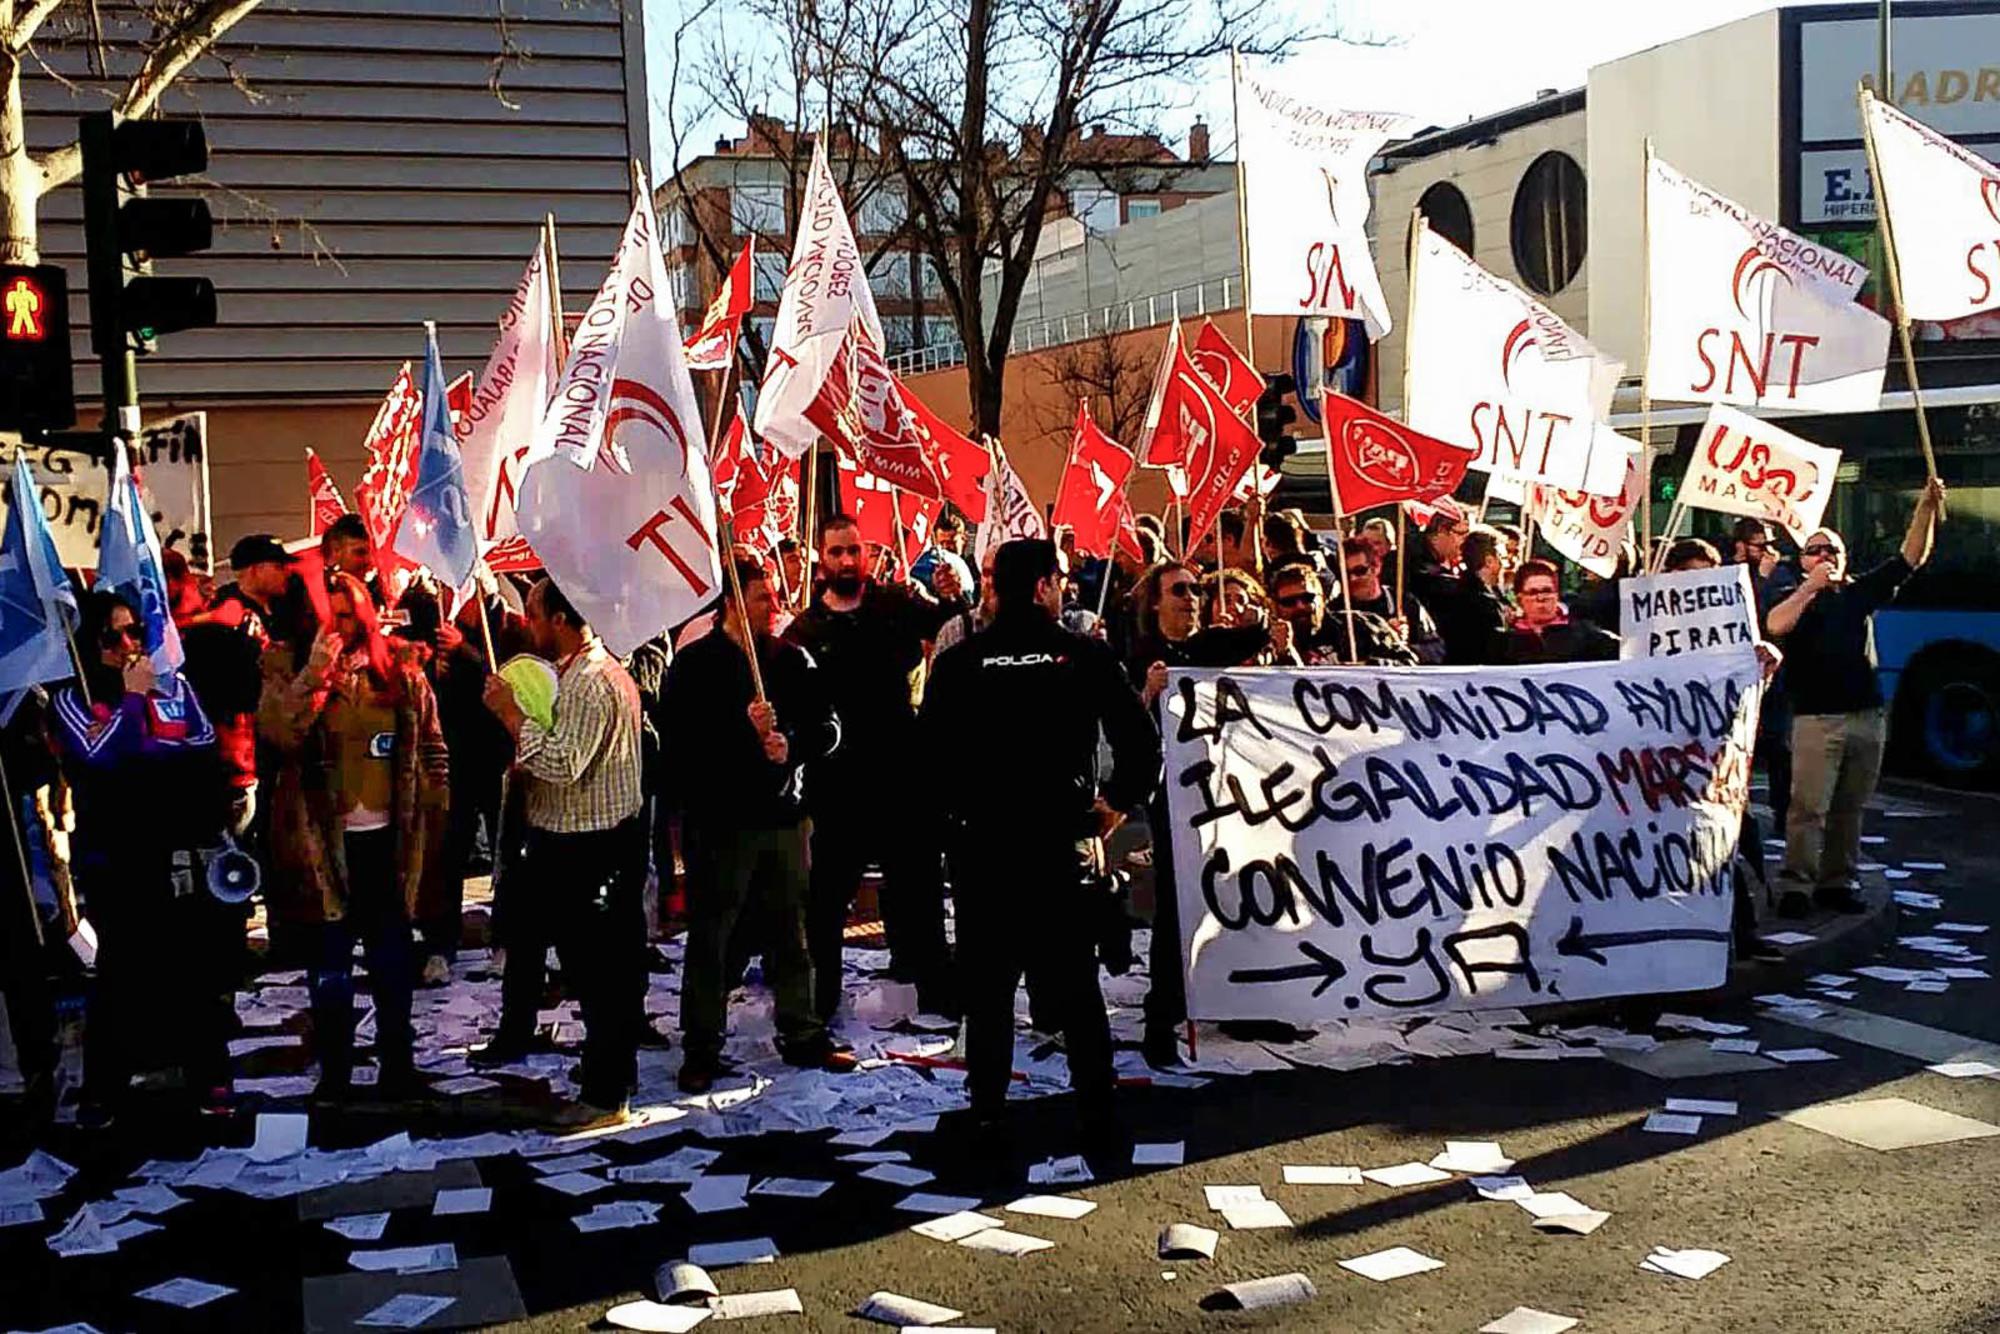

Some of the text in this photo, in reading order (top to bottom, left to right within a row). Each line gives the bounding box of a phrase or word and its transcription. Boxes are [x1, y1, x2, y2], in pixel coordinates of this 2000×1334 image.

[1300, 242, 1355, 311] SN
[553, 332, 607, 450] NACIONAL
[1691, 328, 1820, 399] SNT
[1471, 402, 1571, 475] SNT
[981, 653, 1054, 668] POLICIA
[1648, 622, 1752, 658] PIRATA
[1179, 676, 1273, 744] LA
